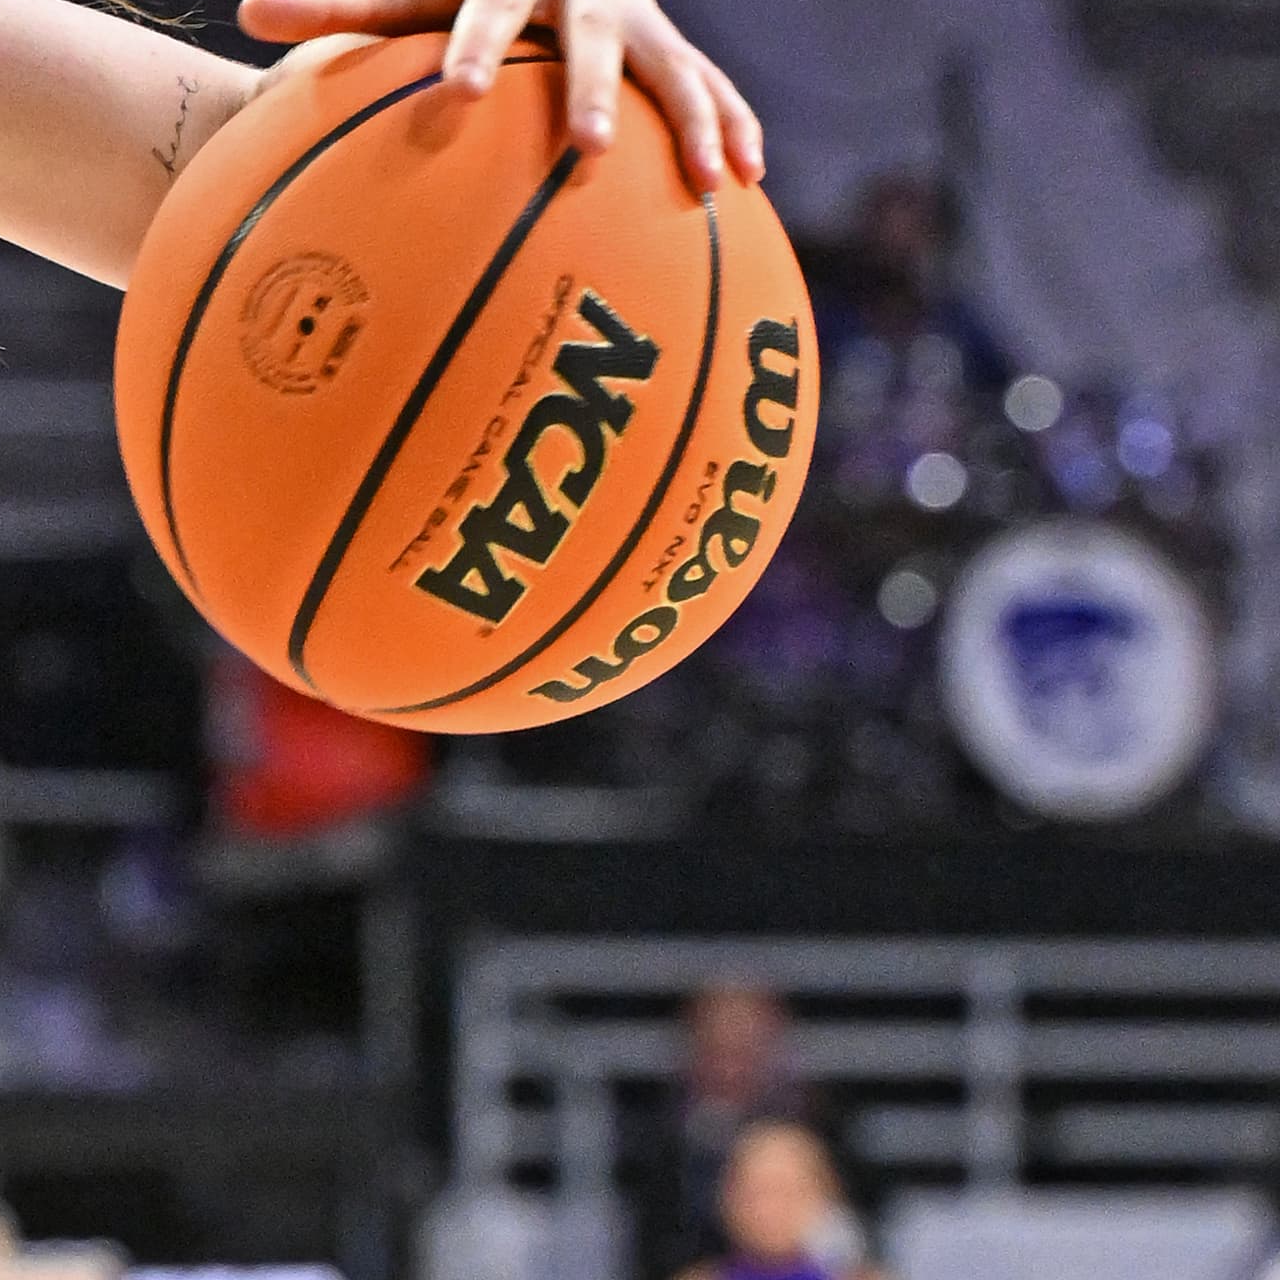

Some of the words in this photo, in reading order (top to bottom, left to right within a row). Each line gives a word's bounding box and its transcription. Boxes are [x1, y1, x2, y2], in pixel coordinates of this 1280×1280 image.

[414, 288, 662, 625] NCAA
[444, 416, 506, 502] GAME
[684, 461, 719, 524] EVO
[527, 317, 800, 702] Wilson
[643, 536, 686, 592] NXT
